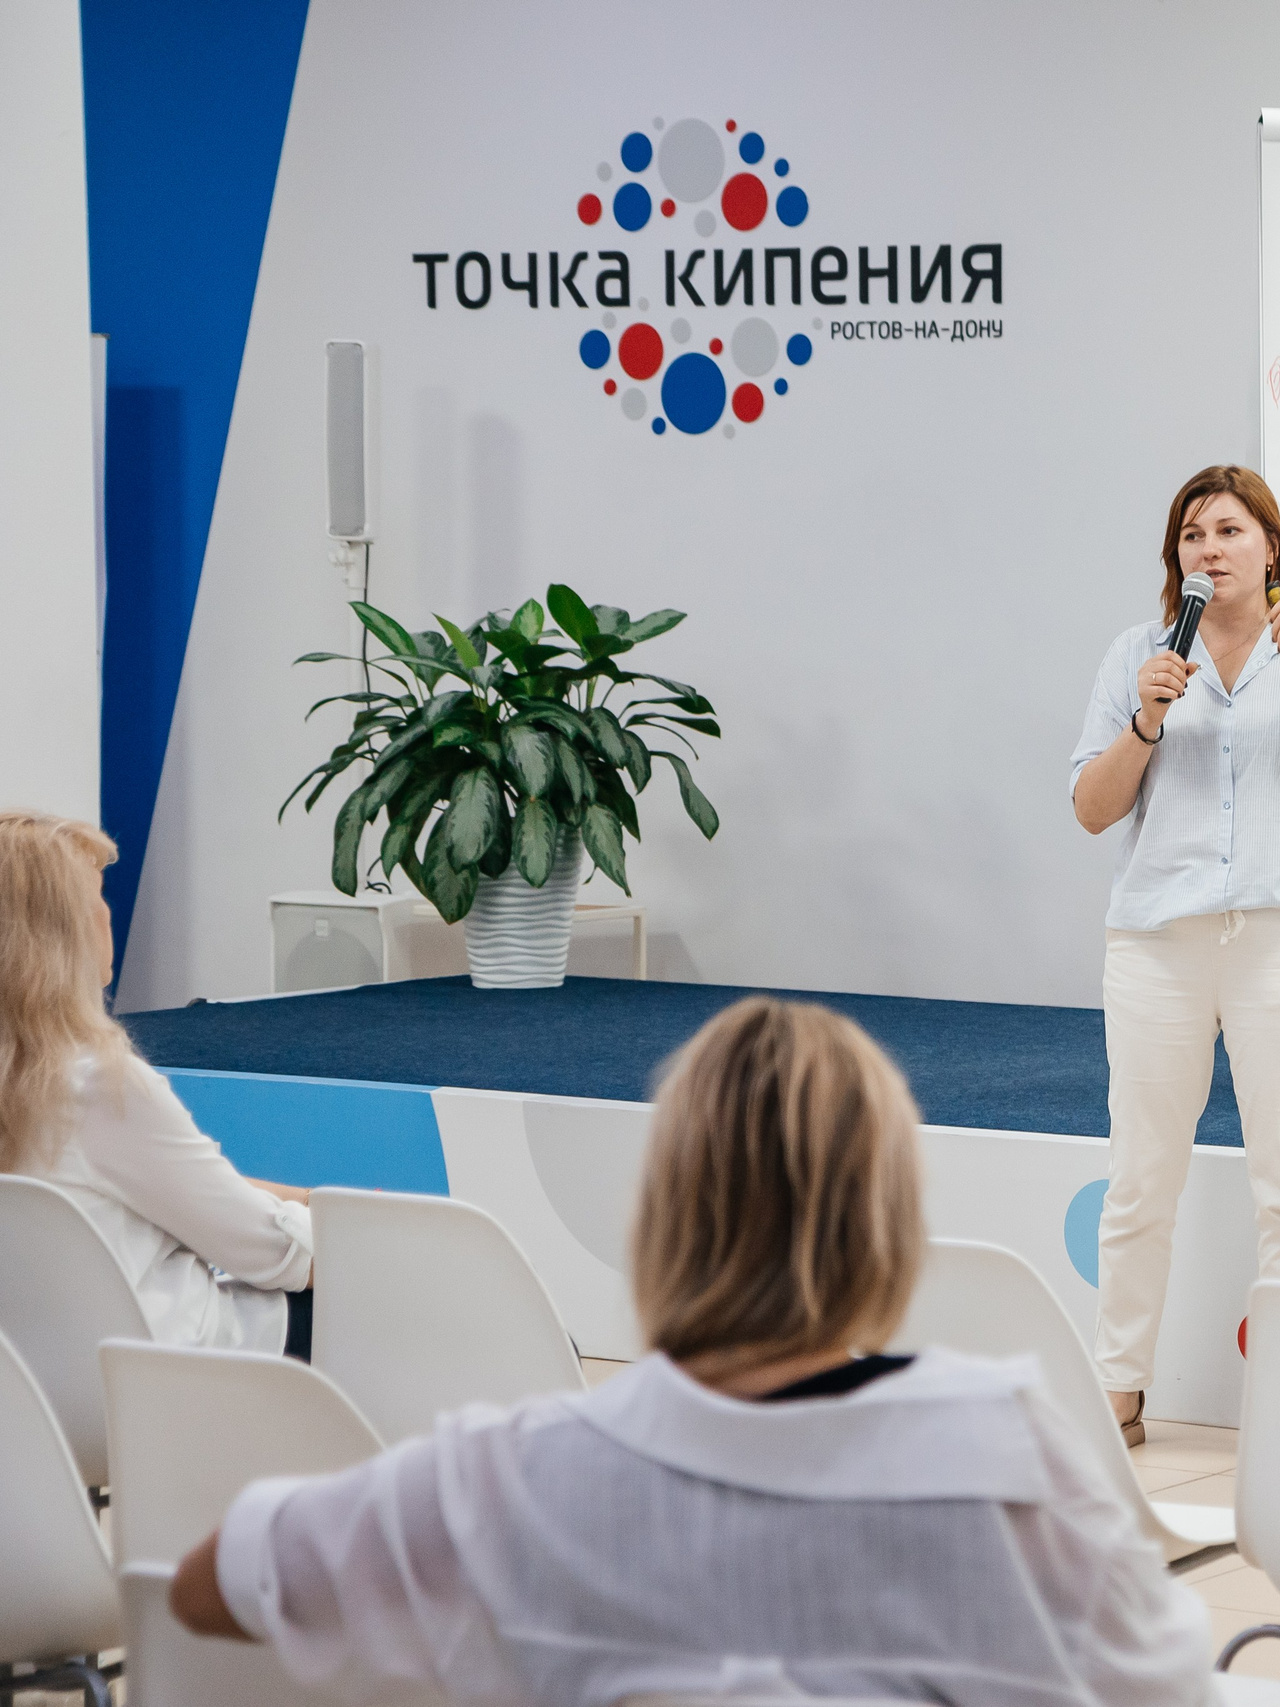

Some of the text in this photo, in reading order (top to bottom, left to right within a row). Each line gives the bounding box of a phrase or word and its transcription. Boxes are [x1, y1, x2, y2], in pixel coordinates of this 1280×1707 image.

[412, 243, 1003, 309] точка кипения
[830, 319, 1003, 342] РОСТОВ-НА-ДОНУ
